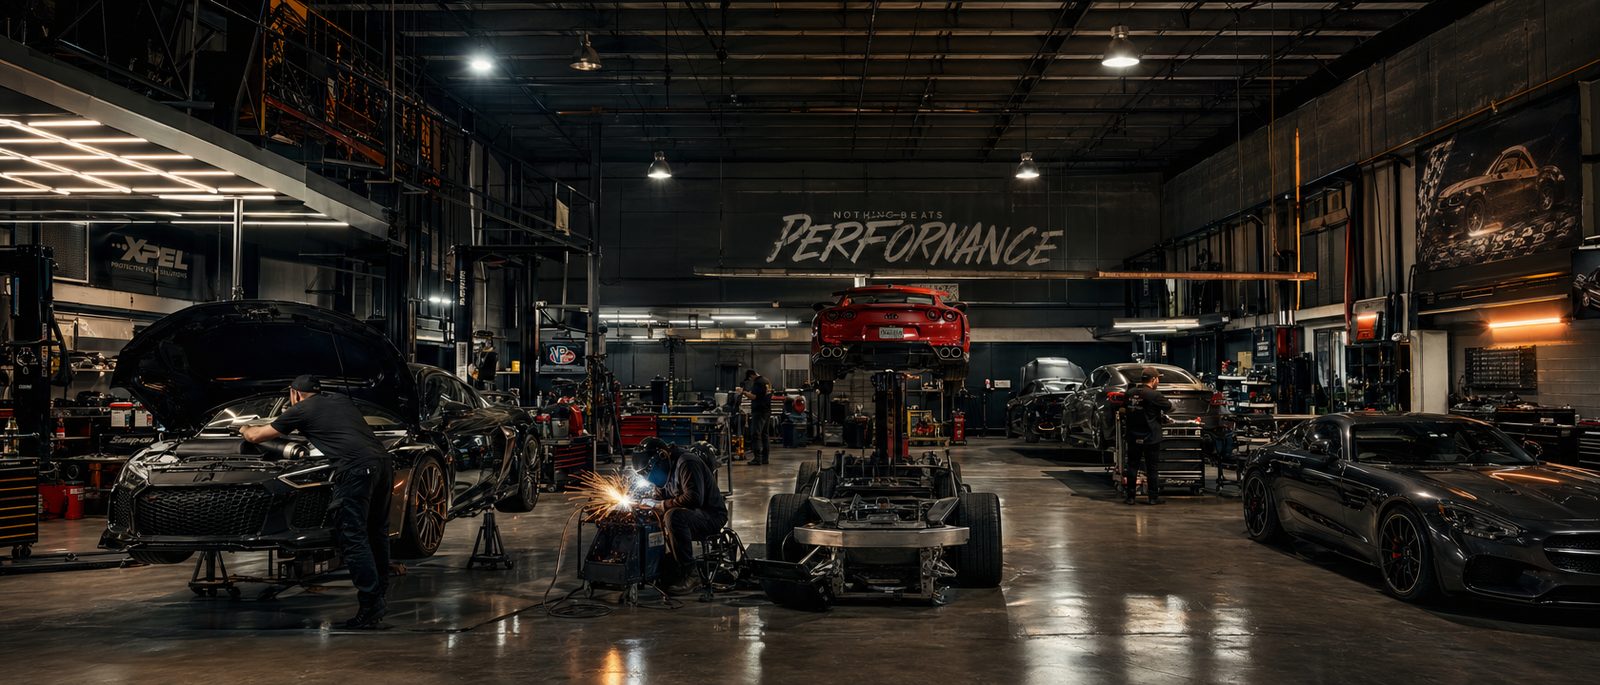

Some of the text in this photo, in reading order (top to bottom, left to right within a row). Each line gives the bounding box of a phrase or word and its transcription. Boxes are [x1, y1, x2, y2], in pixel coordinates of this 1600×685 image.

[833, 211, 943, 219] NOTHING BEATS
[120, 235, 188, 271] XPEL
